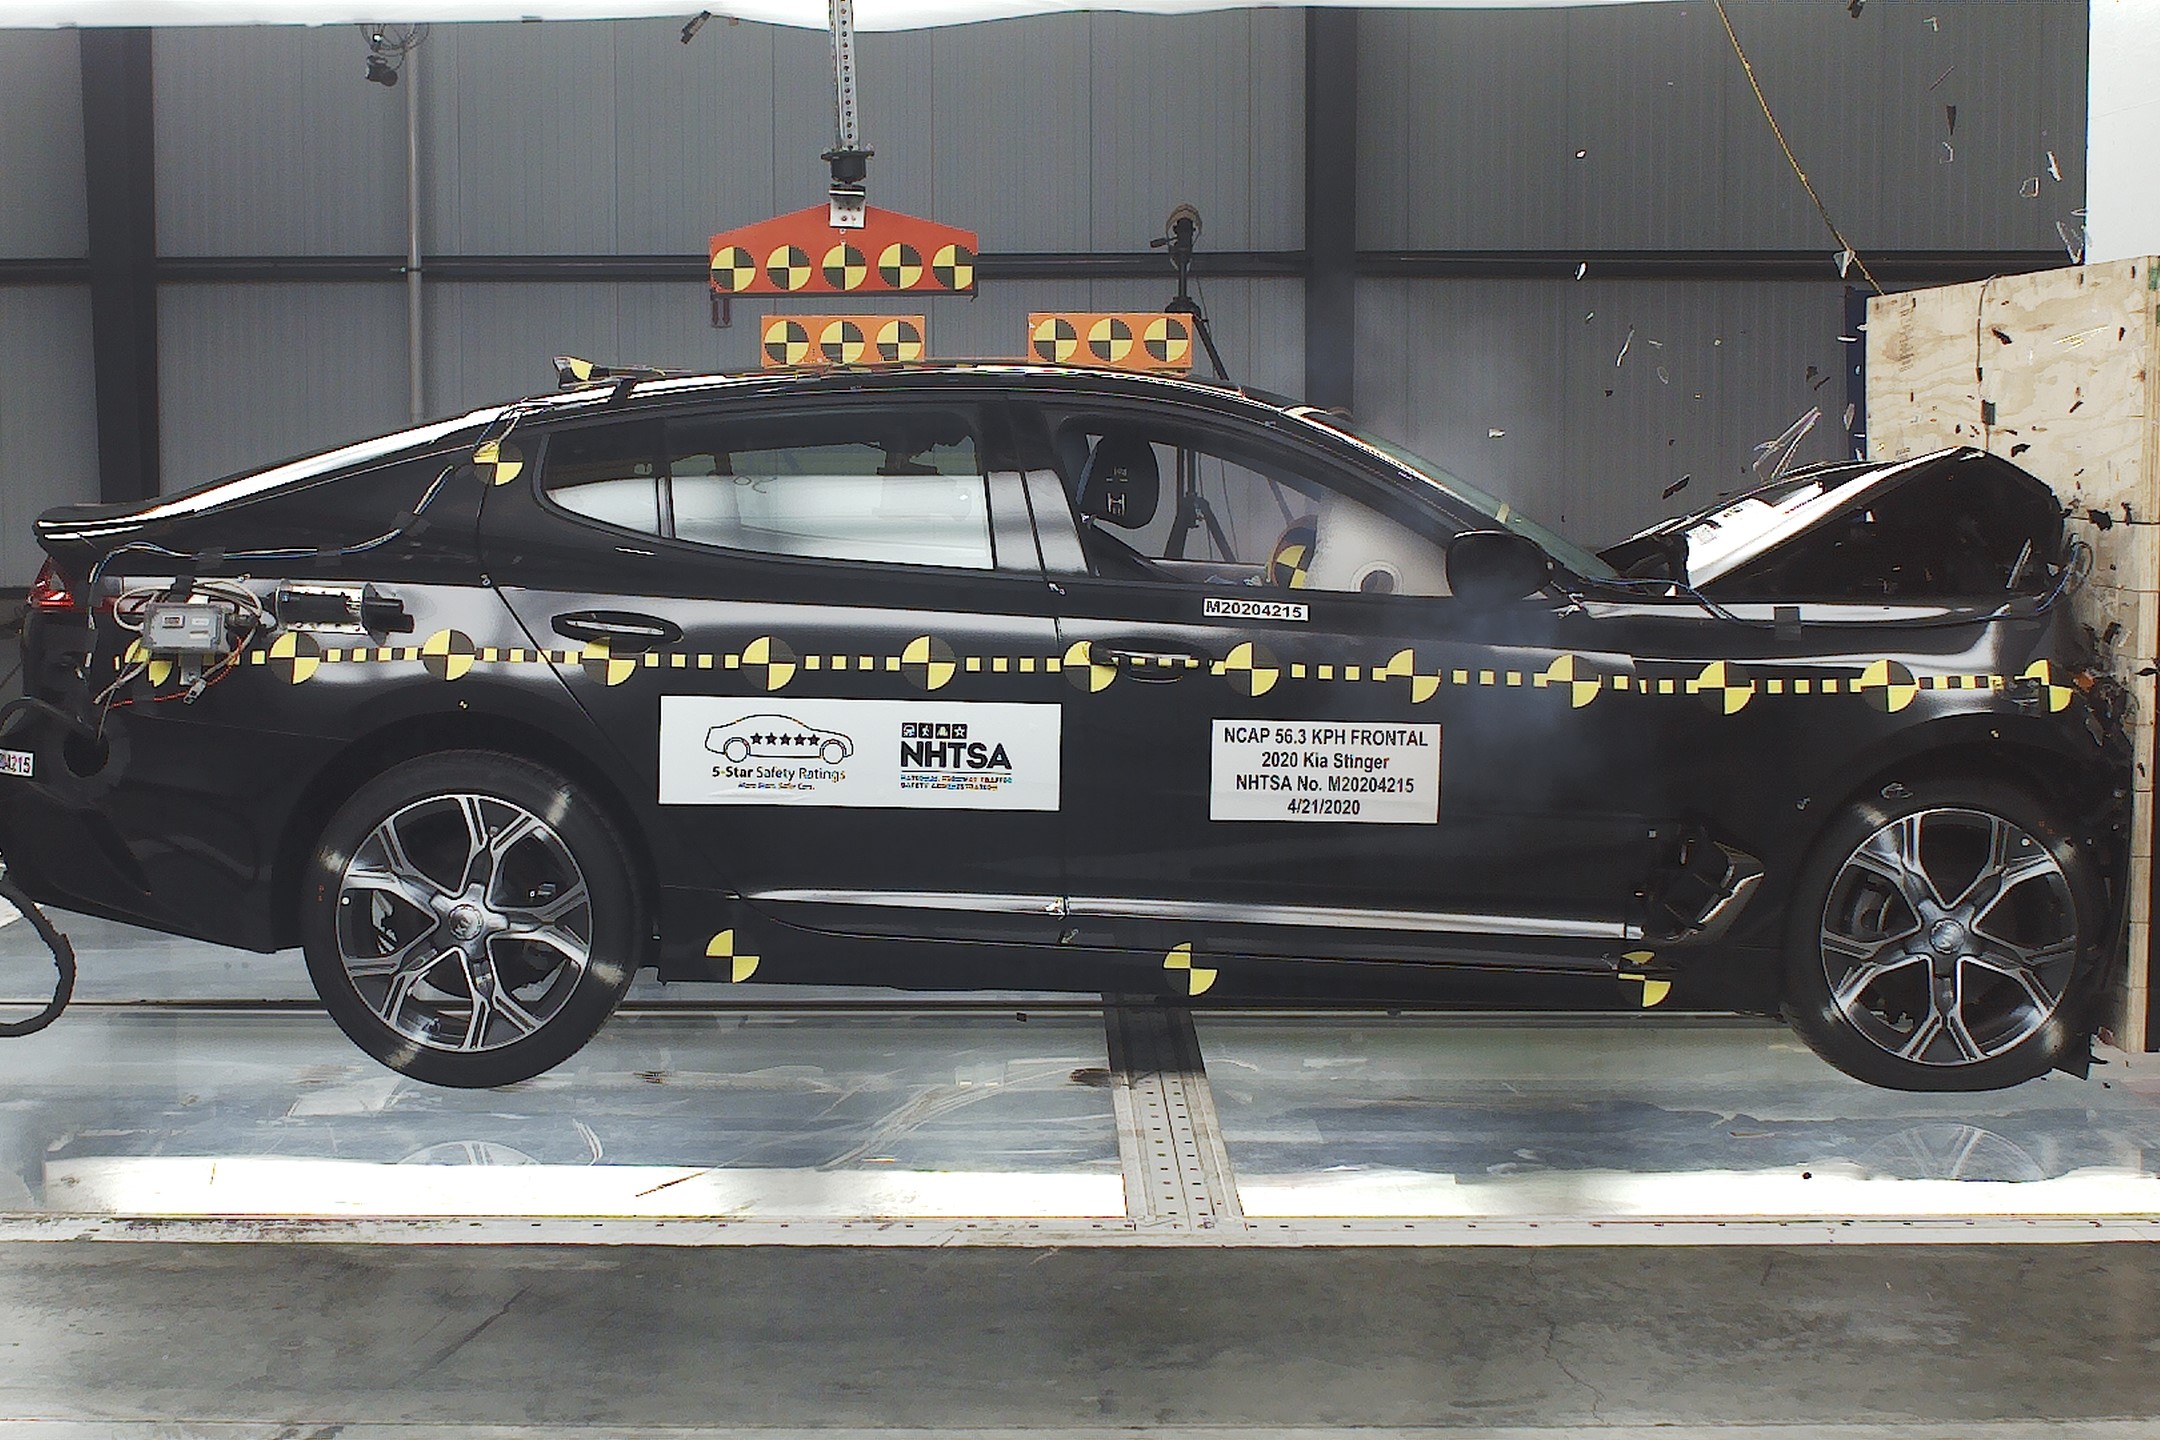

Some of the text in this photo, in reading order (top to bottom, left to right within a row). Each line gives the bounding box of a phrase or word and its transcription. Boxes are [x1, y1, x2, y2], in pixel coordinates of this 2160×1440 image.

[1205, 600, 1302, 618] M20204215
[1224, 727, 1428, 746] NCAP 56.3 KPH FRONTAL
[901, 741, 1012, 769] NHTSA
[1261, 752, 1389, 772] 2020 Kia Stinger
[712, 766, 846, 783] 5-Star Safety Ratings
[1236, 774, 1414, 793] NHTSA No. M20204215
[1287, 798, 1360, 815] 4/21/2020
